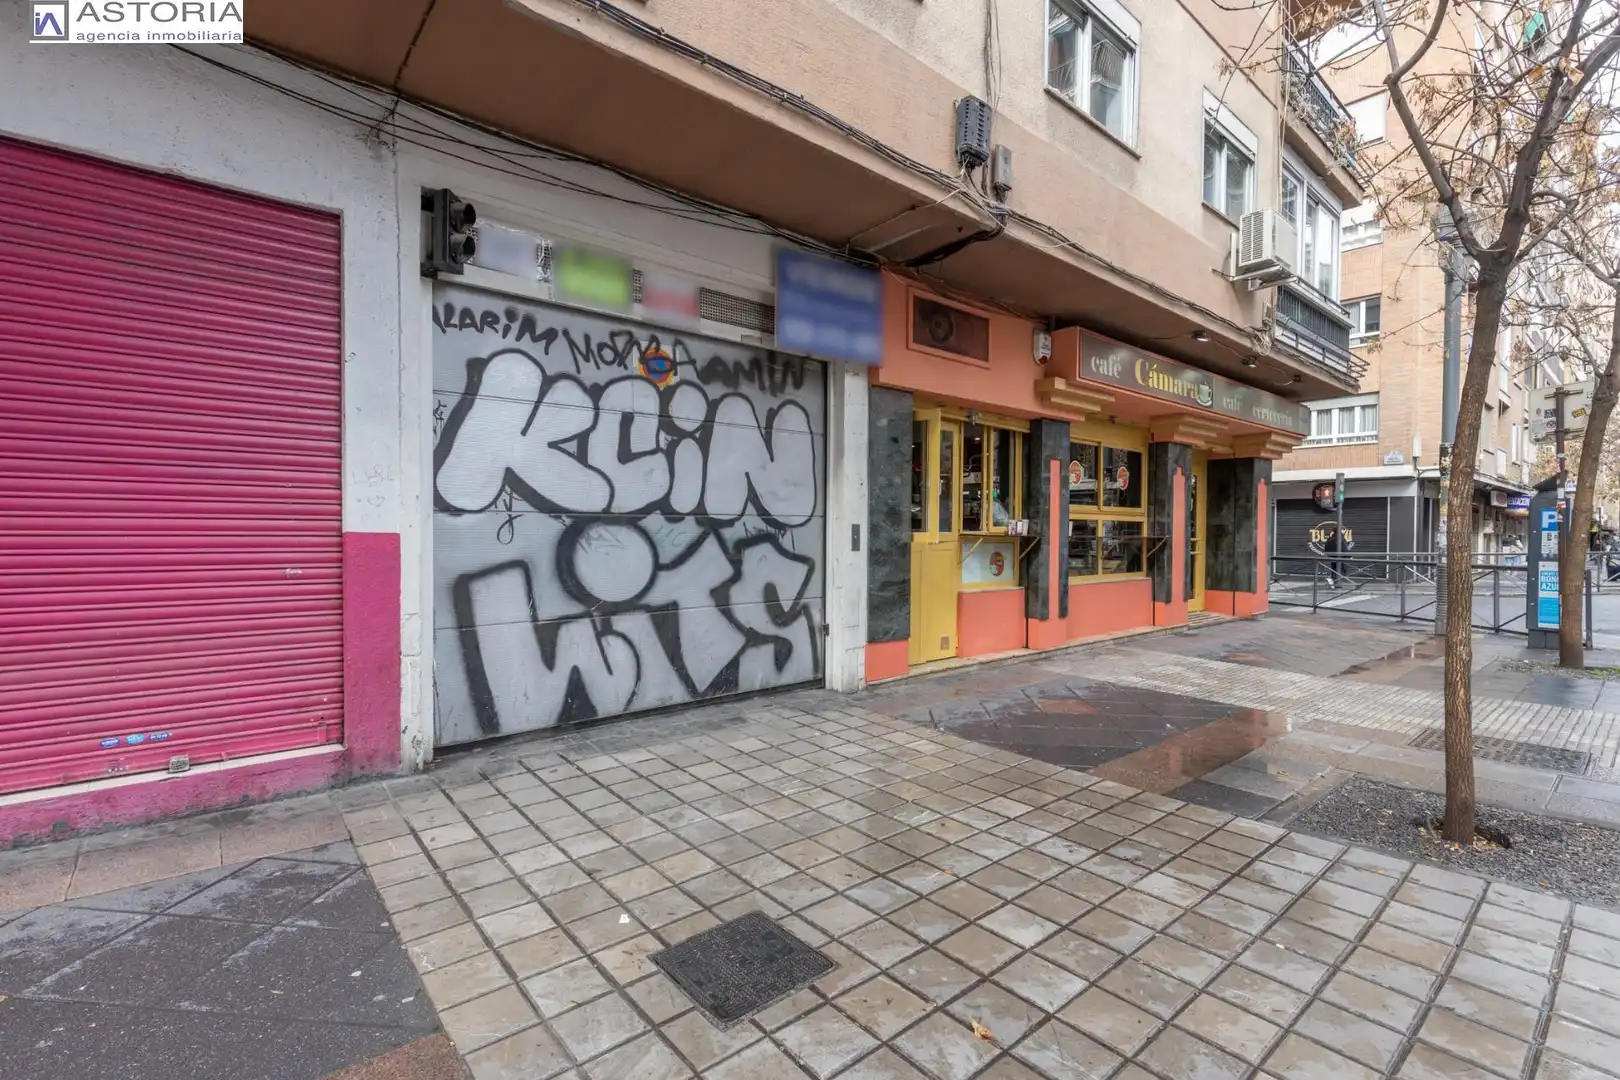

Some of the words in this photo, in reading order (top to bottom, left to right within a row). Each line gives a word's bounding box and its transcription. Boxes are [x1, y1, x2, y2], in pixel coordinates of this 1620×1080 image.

[1091, 355, 1122, 379] café
[1135, 358, 1198, 399] Cámara
[1541, 511, 1559, 529] P
